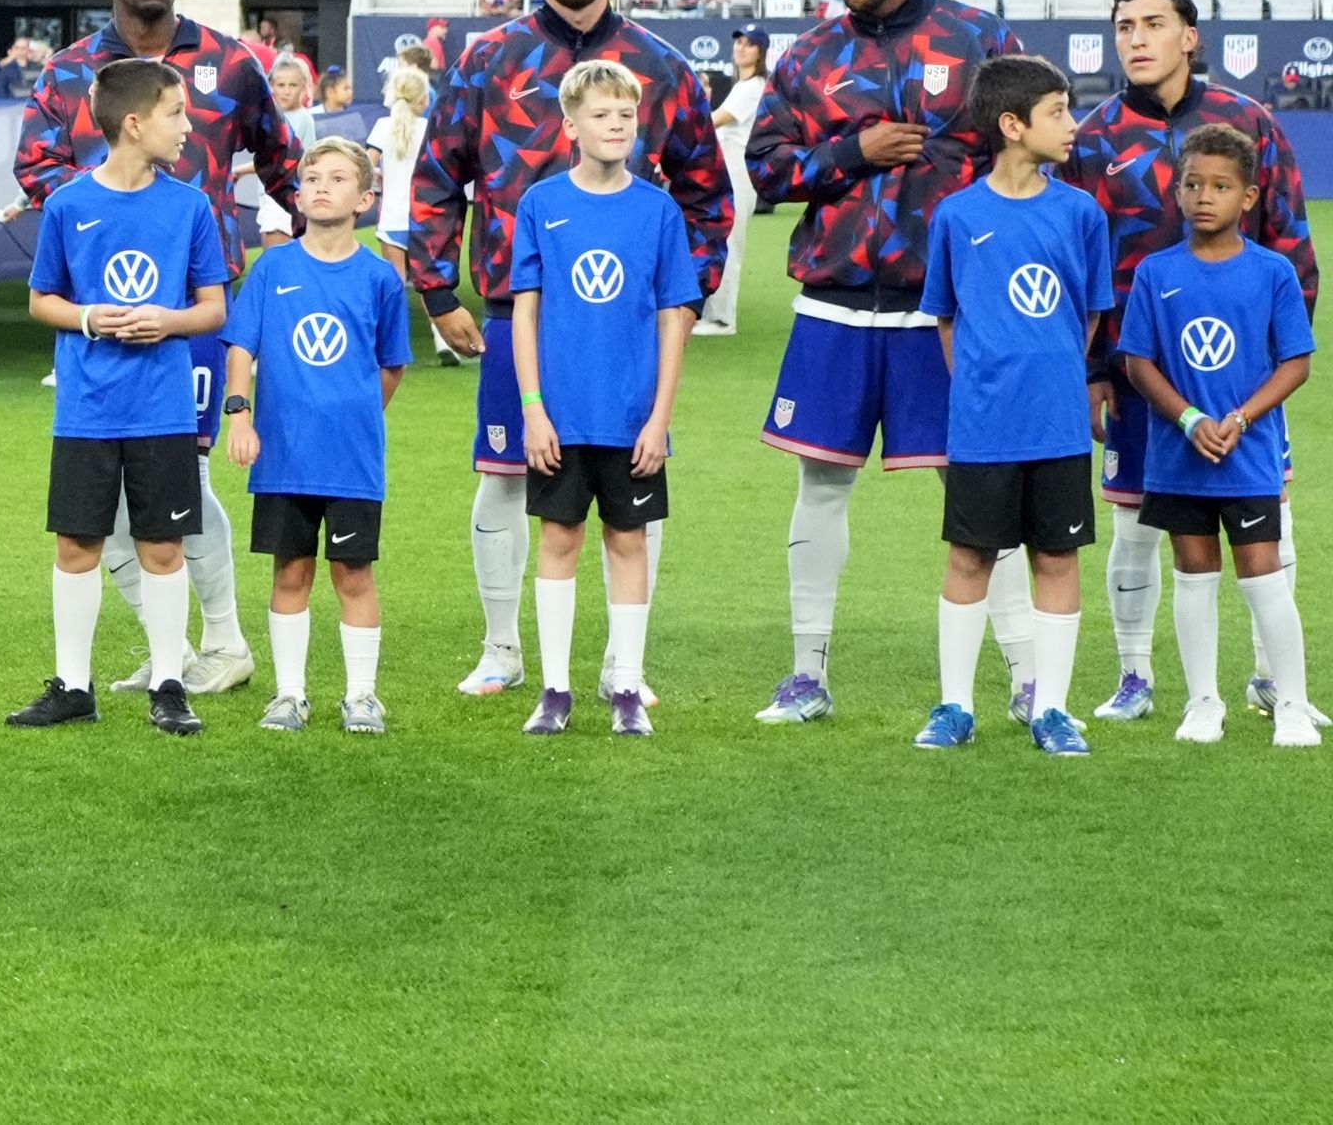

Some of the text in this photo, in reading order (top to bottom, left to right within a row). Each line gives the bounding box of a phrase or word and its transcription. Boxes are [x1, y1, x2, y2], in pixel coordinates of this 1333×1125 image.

[1072, 36, 1099, 53] USA
[1226, 38, 1254, 54] USA
[197, 68, 216, 78] USA
[927, 66, 947, 76] USA
[777, 399, 795, 411] USA
[489, 427, 505, 437] USA
